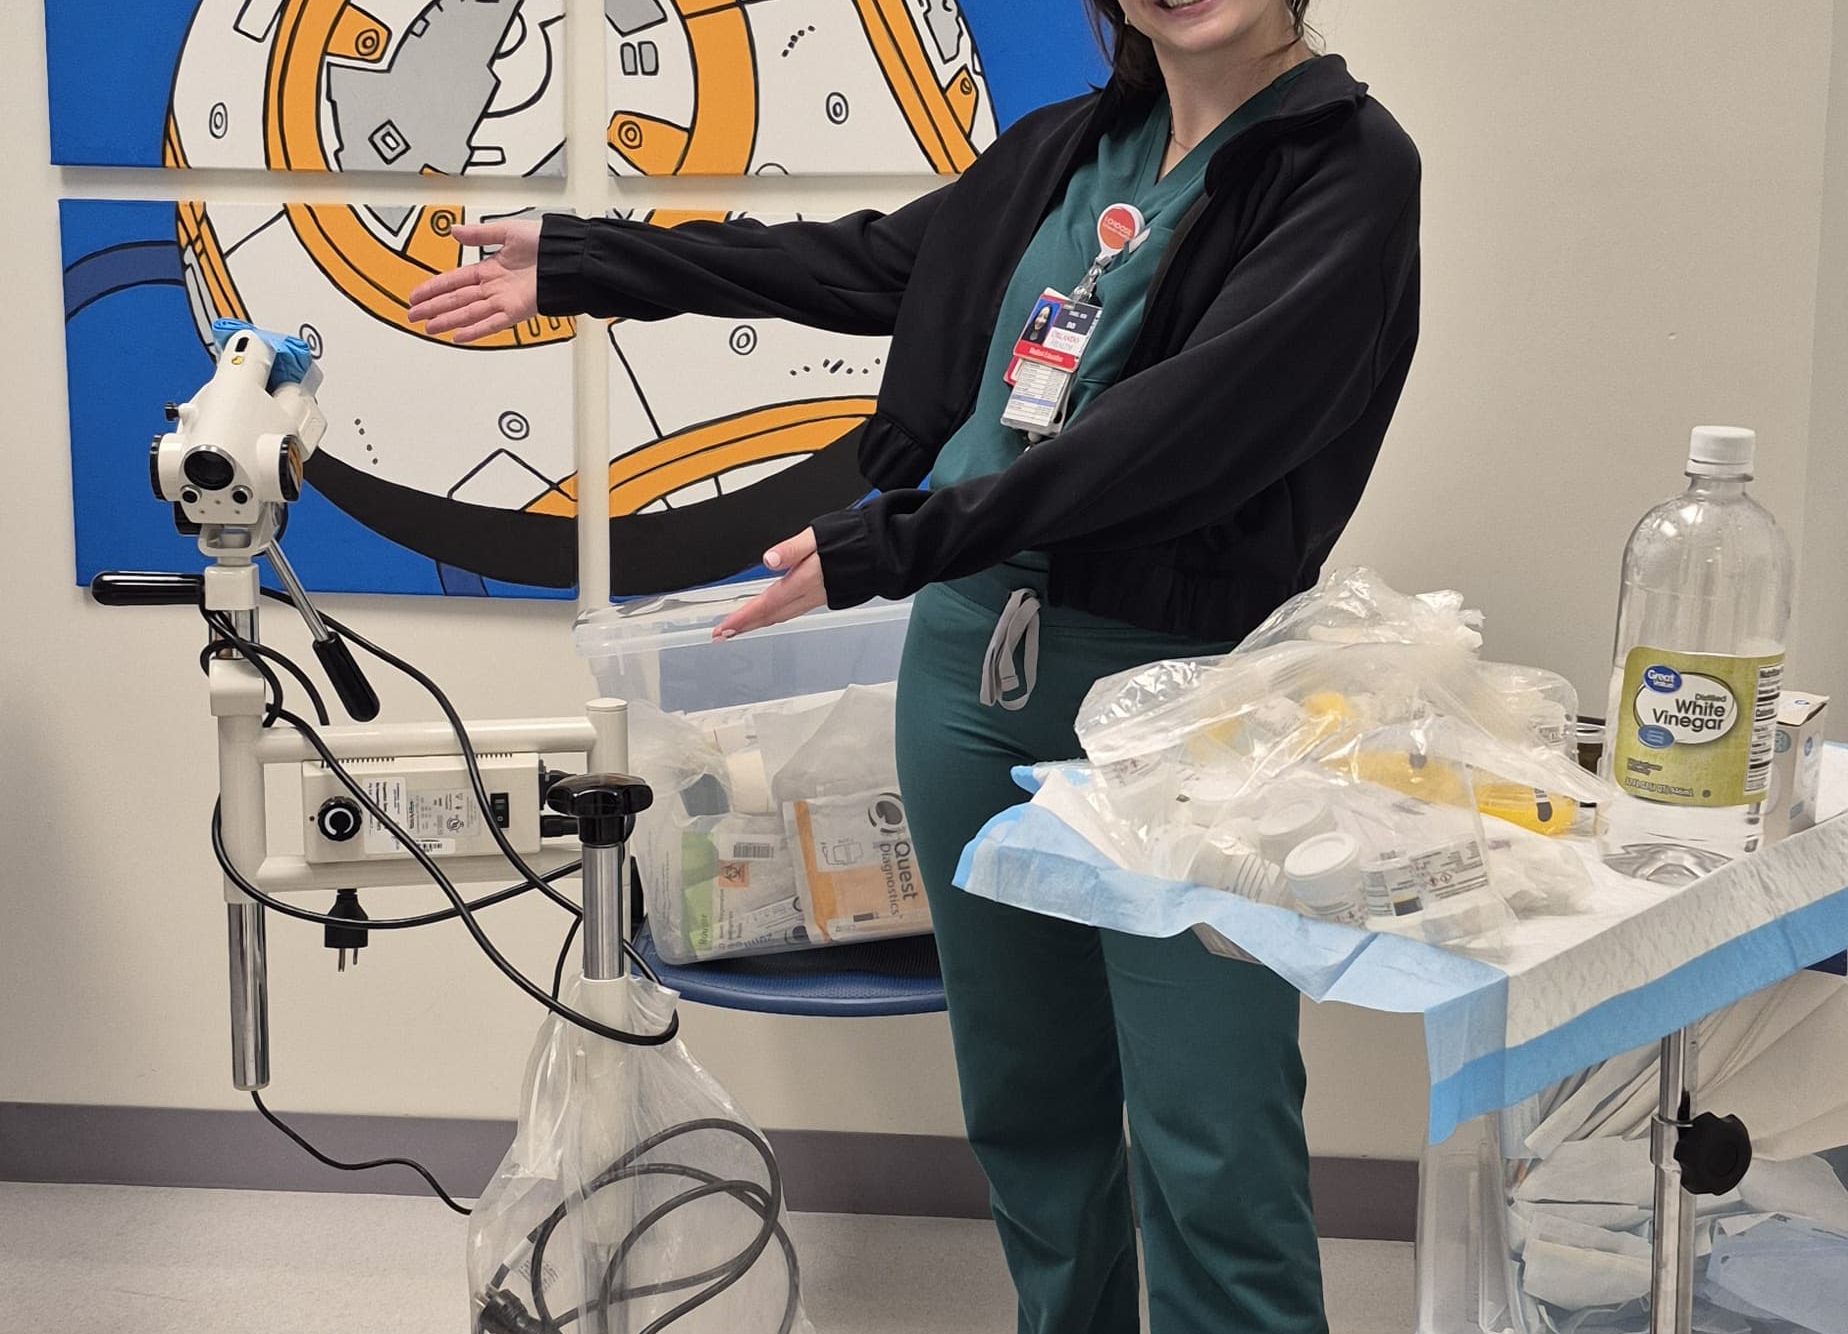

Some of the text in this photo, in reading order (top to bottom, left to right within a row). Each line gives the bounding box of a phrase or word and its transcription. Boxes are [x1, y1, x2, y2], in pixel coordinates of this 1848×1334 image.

[1647, 669, 1675, 684] Great
[1675, 698, 1726, 718] White
[1695, 693, 1727, 703] Distilled
[1652, 708, 1724, 733] Vinegar
[893, 841, 919, 901] Quest
